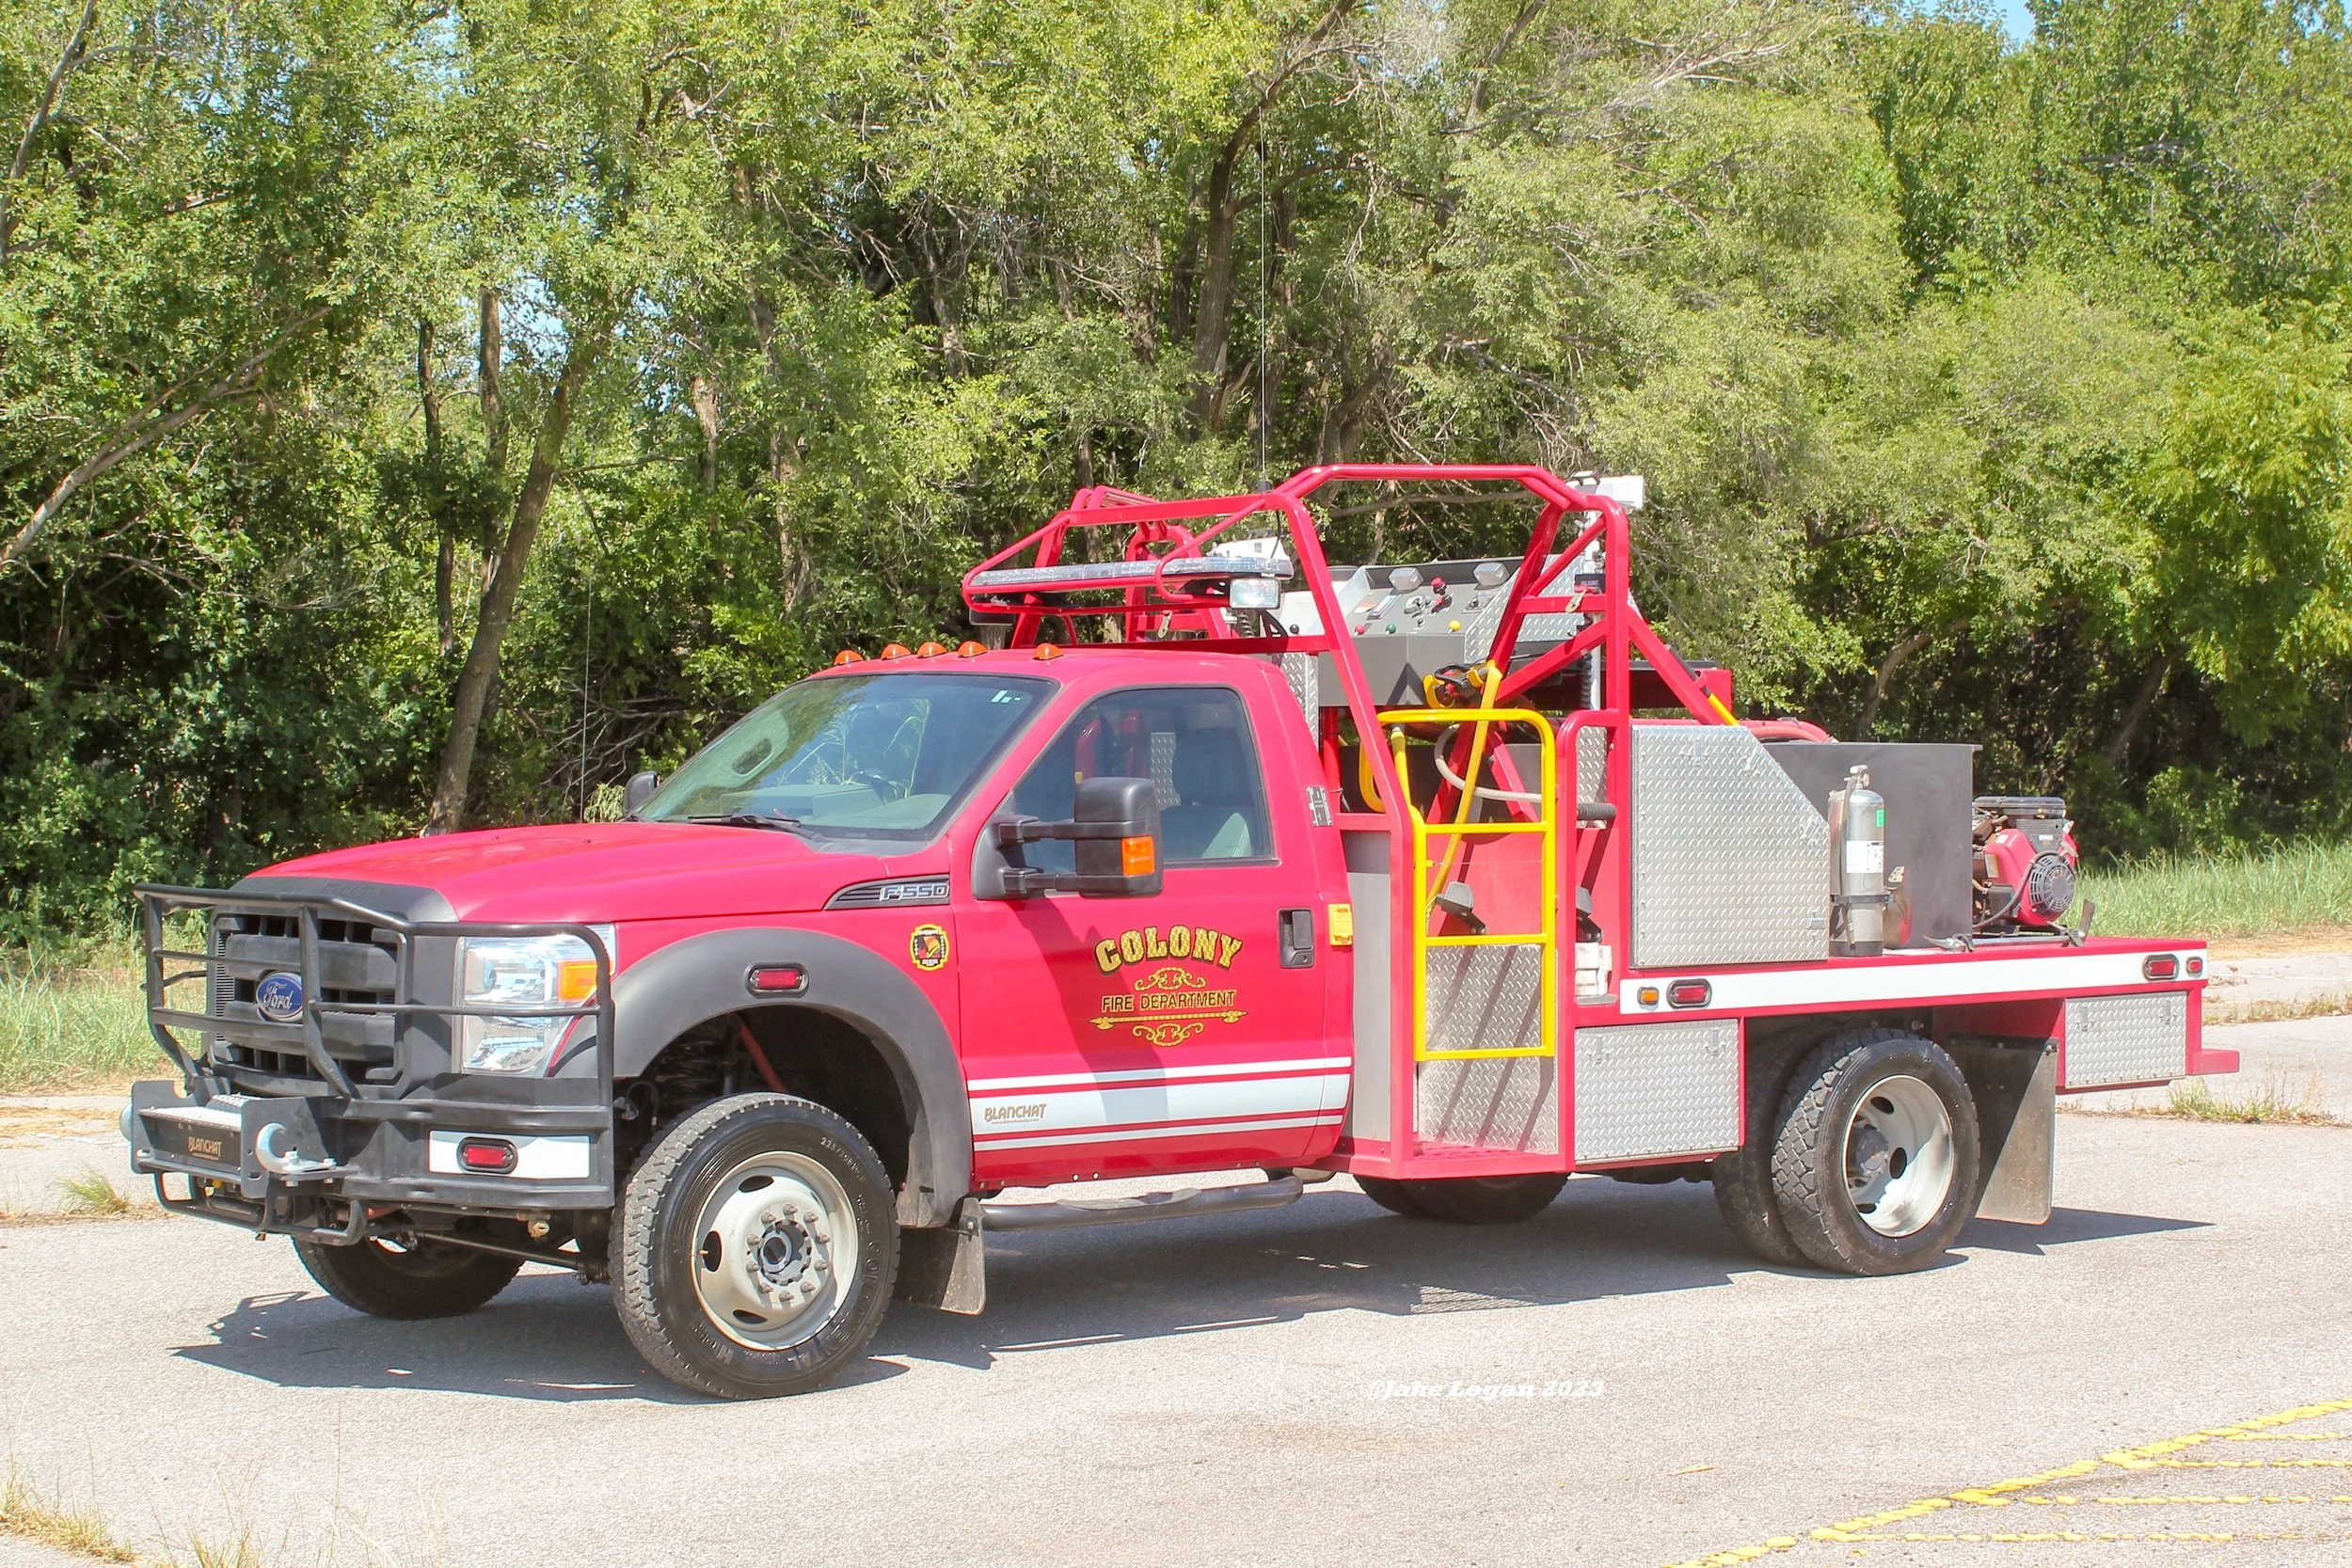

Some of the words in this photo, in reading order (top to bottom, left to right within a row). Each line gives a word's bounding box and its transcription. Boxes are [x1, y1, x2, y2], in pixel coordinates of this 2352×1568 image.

[1095, 926, 1243, 975] COLONY
[263, 981, 294, 1009] Ford
[1102, 994, 1135, 1013] FIRE
[1140, 990, 1237, 1012] DEPARTMENT
[984, 1103, 1047, 1122] BLANCHAT
